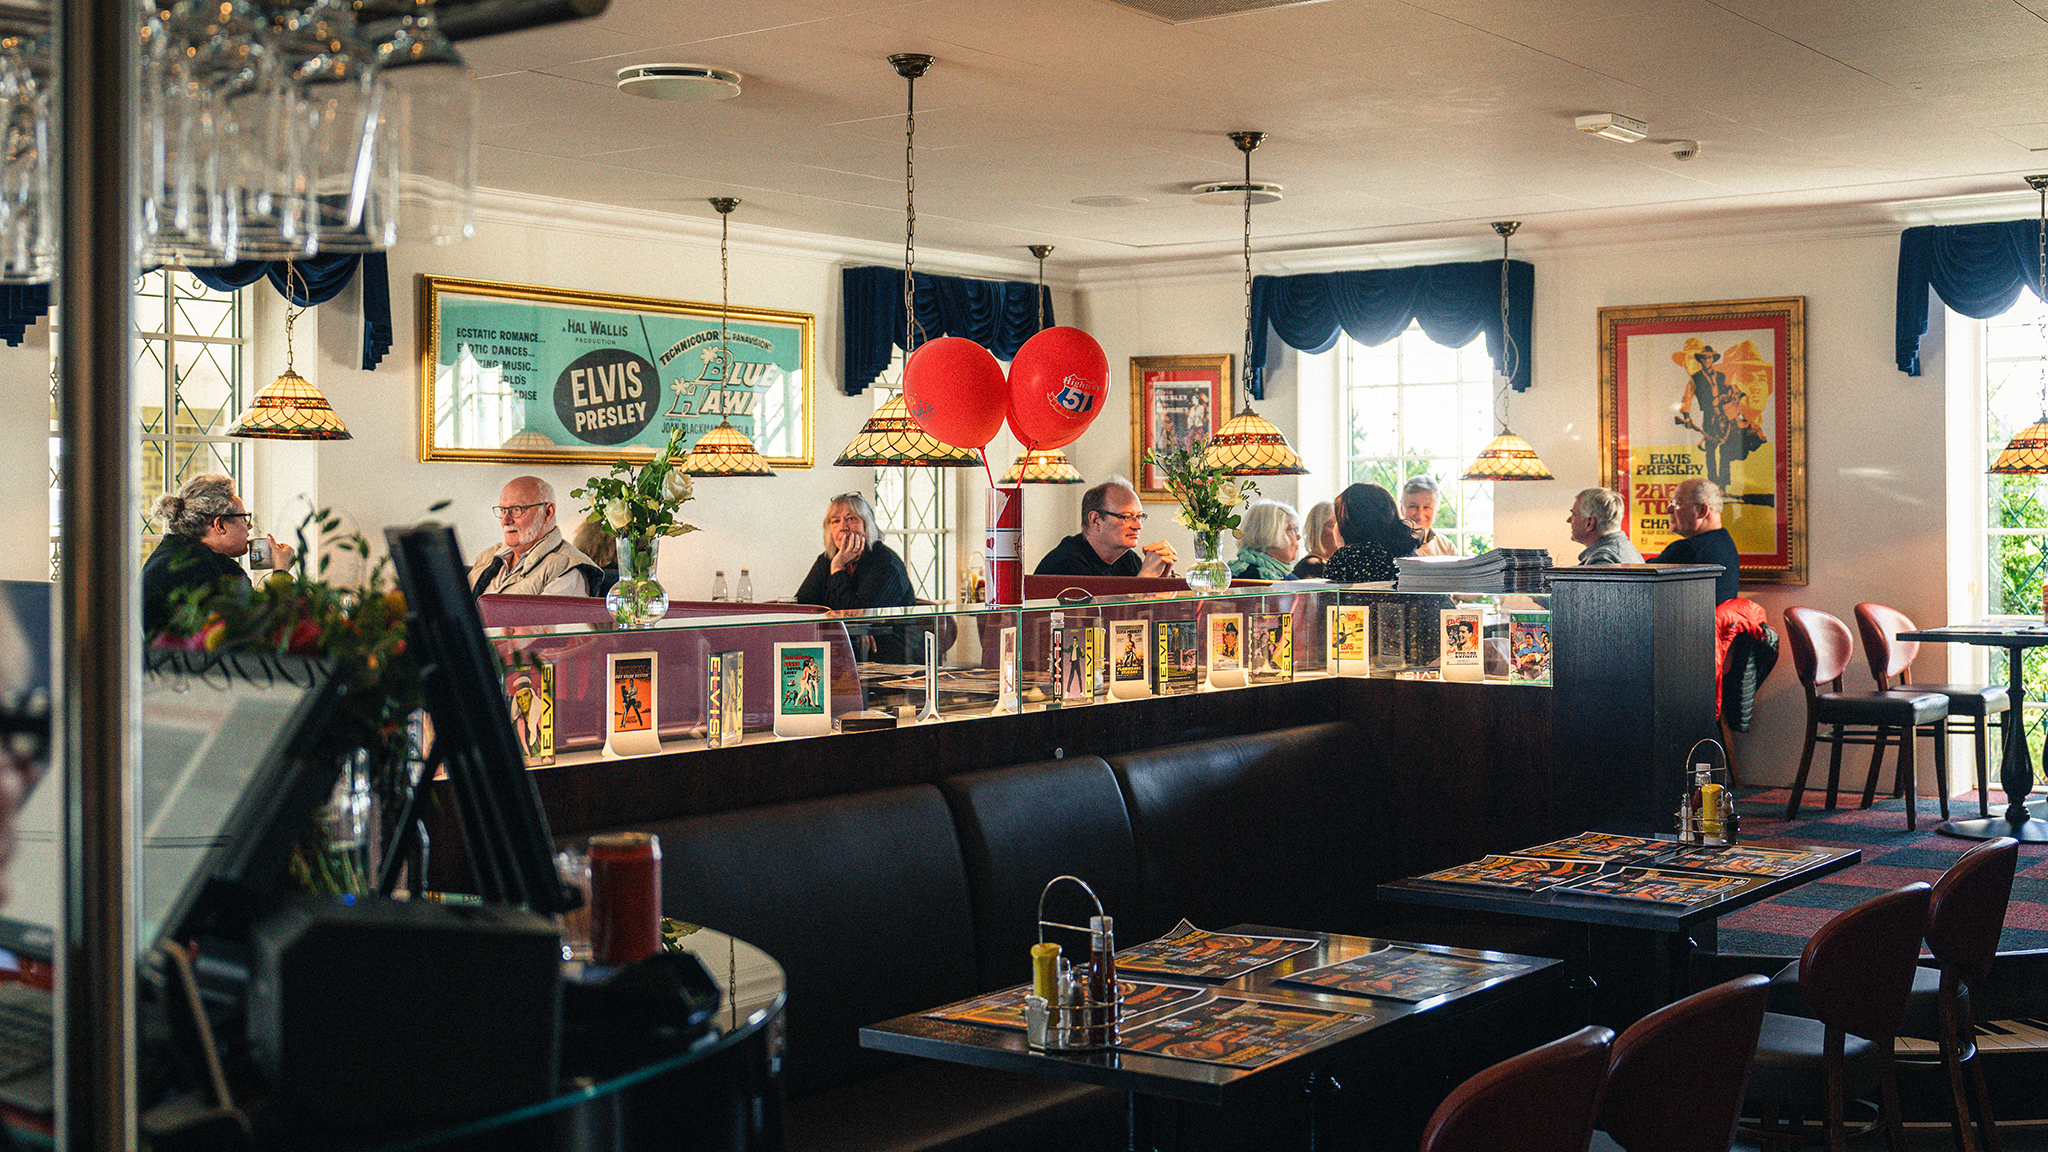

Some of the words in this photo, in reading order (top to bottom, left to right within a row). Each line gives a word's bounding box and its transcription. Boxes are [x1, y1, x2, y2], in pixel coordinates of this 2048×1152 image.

[457, 328, 497, 340] ECSTATIC
[568, 319, 587, 334] HAL
[590, 321, 629, 338] WALLIS
[457, 343, 489, 354] EOTIC
[575, 337, 617, 346] PRODUCTION
[660, 331, 719, 366] TECHNICOLOR
[570, 361, 643, 408] ELVIS
[1063, 387, 1090, 413] 51
[574, 401, 647, 432] PRESLEY
[1650, 454, 1691, 464] ELVIS
[1636, 465, 1703, 475] PRESLEY
[1641, 519, 1669, 529] CHA
[1054, 630, 1062, 695] ELVIS
[1404, 671, 1439, 680] LVIS
[710, 657, 721, 735] ELVIS
